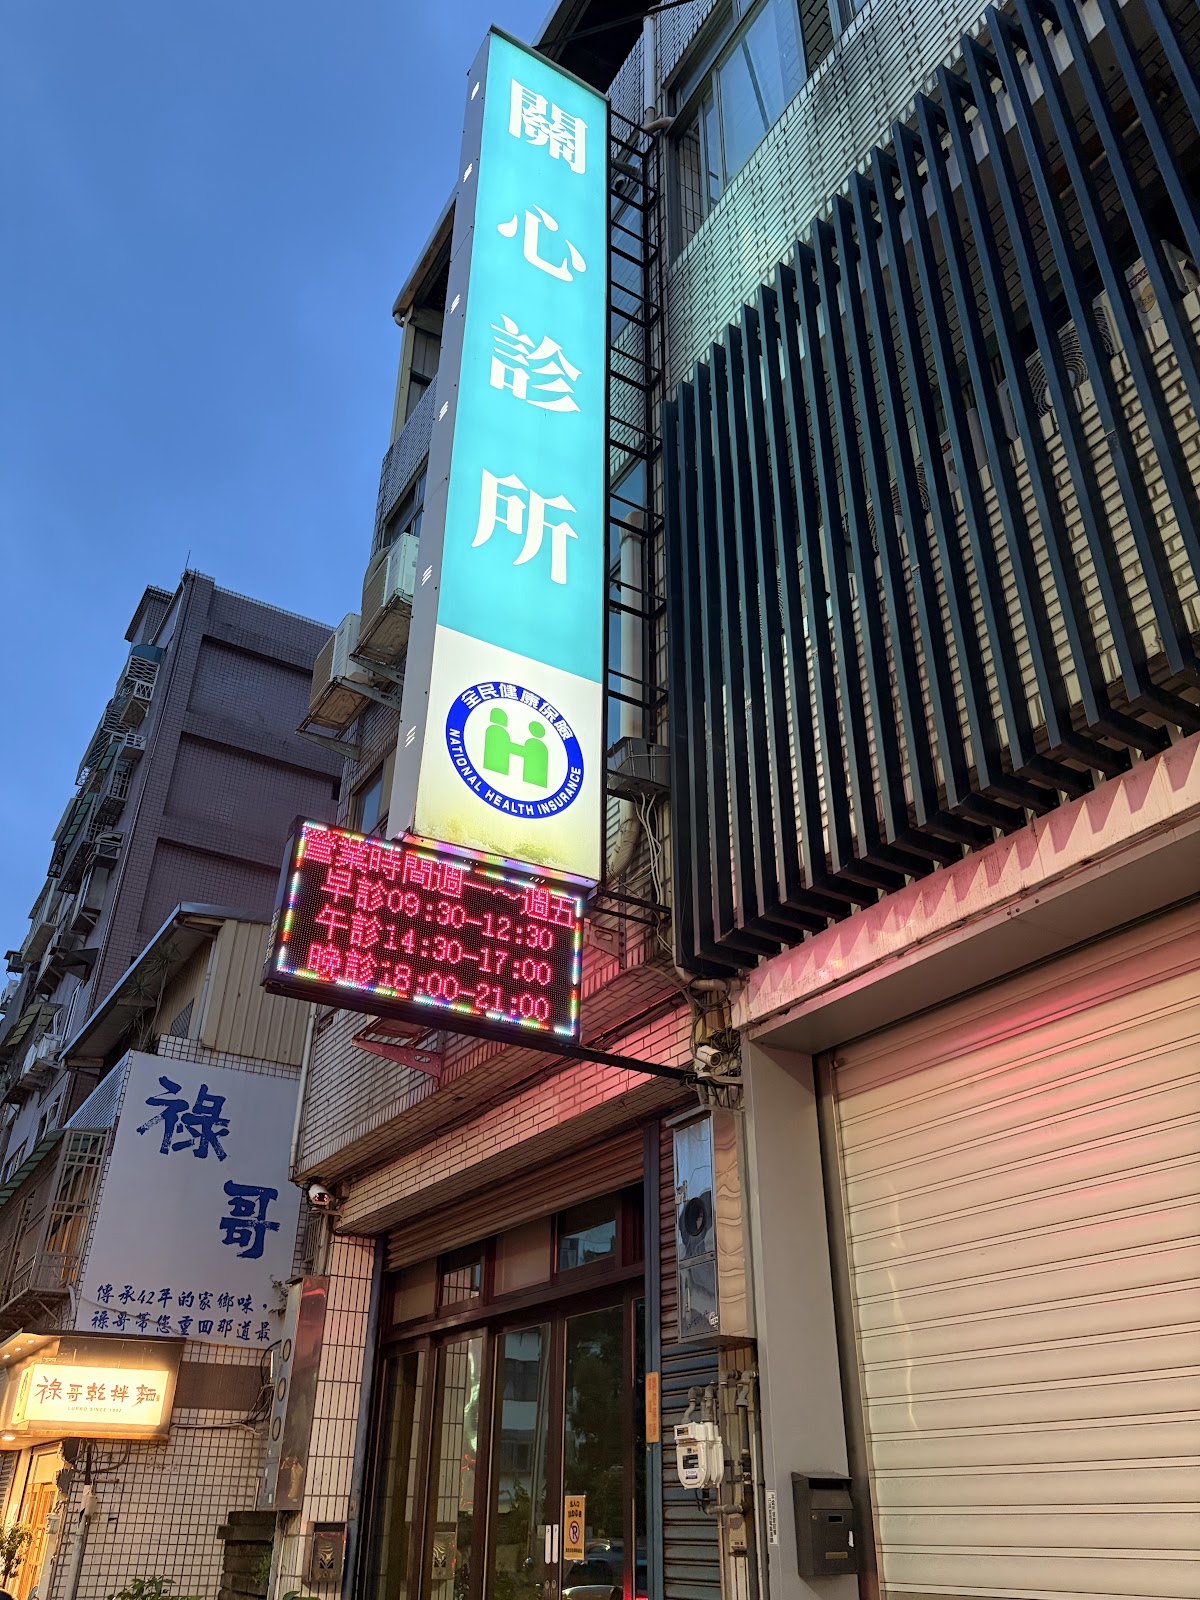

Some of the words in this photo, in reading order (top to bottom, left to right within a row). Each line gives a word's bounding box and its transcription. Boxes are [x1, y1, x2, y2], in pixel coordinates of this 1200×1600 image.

[471, 77, 589, 585] 關心診所
[461, 683, 573, 740] 全民健康保險
[449, 728, 481, 791] NATIONAL
[485, 791, 535, 816] HEALTH
[537, 766, 581, 815] INSURANCE
